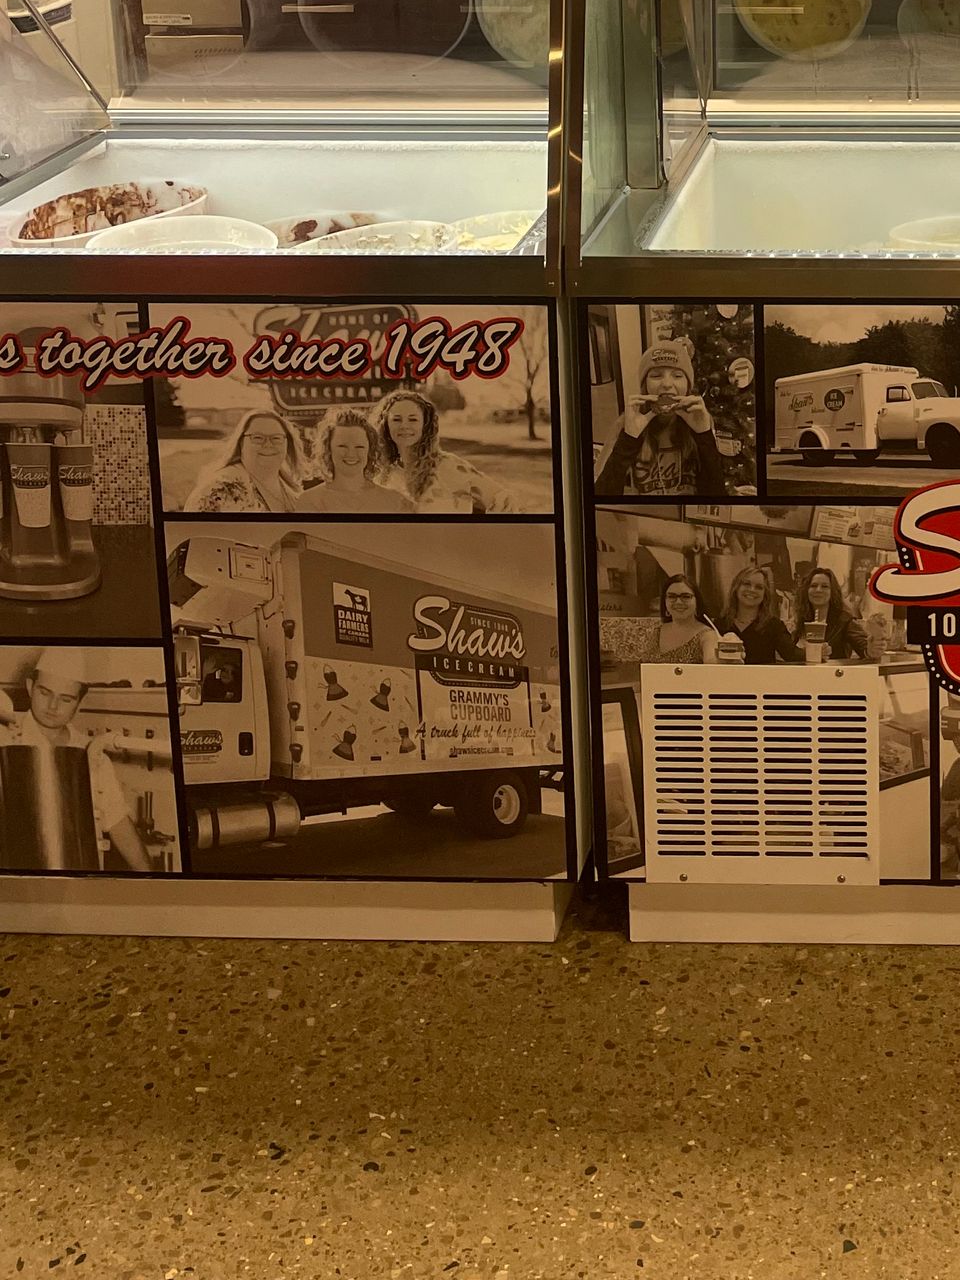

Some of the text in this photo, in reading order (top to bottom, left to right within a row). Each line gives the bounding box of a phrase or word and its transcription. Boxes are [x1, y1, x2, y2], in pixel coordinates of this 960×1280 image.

[41, 321, 230, 386] together
[249, 334, 366, 371] since
[387, 321, 517, 372] 1948
[338, 610, 368, 621] DAIRY
[338, 620, 368, 632] FARMERS
[408, 596, 526, 659] Shaw's
[449, 690, 509, 706] GRAMMY'S
[450, 705, 512, 722] CUPBOARD
[416, 722, 426, 737] A
[430, 724, 459, 738] truck
[462, 724, 480, 744] full
[483, 725, 494, 744] of
